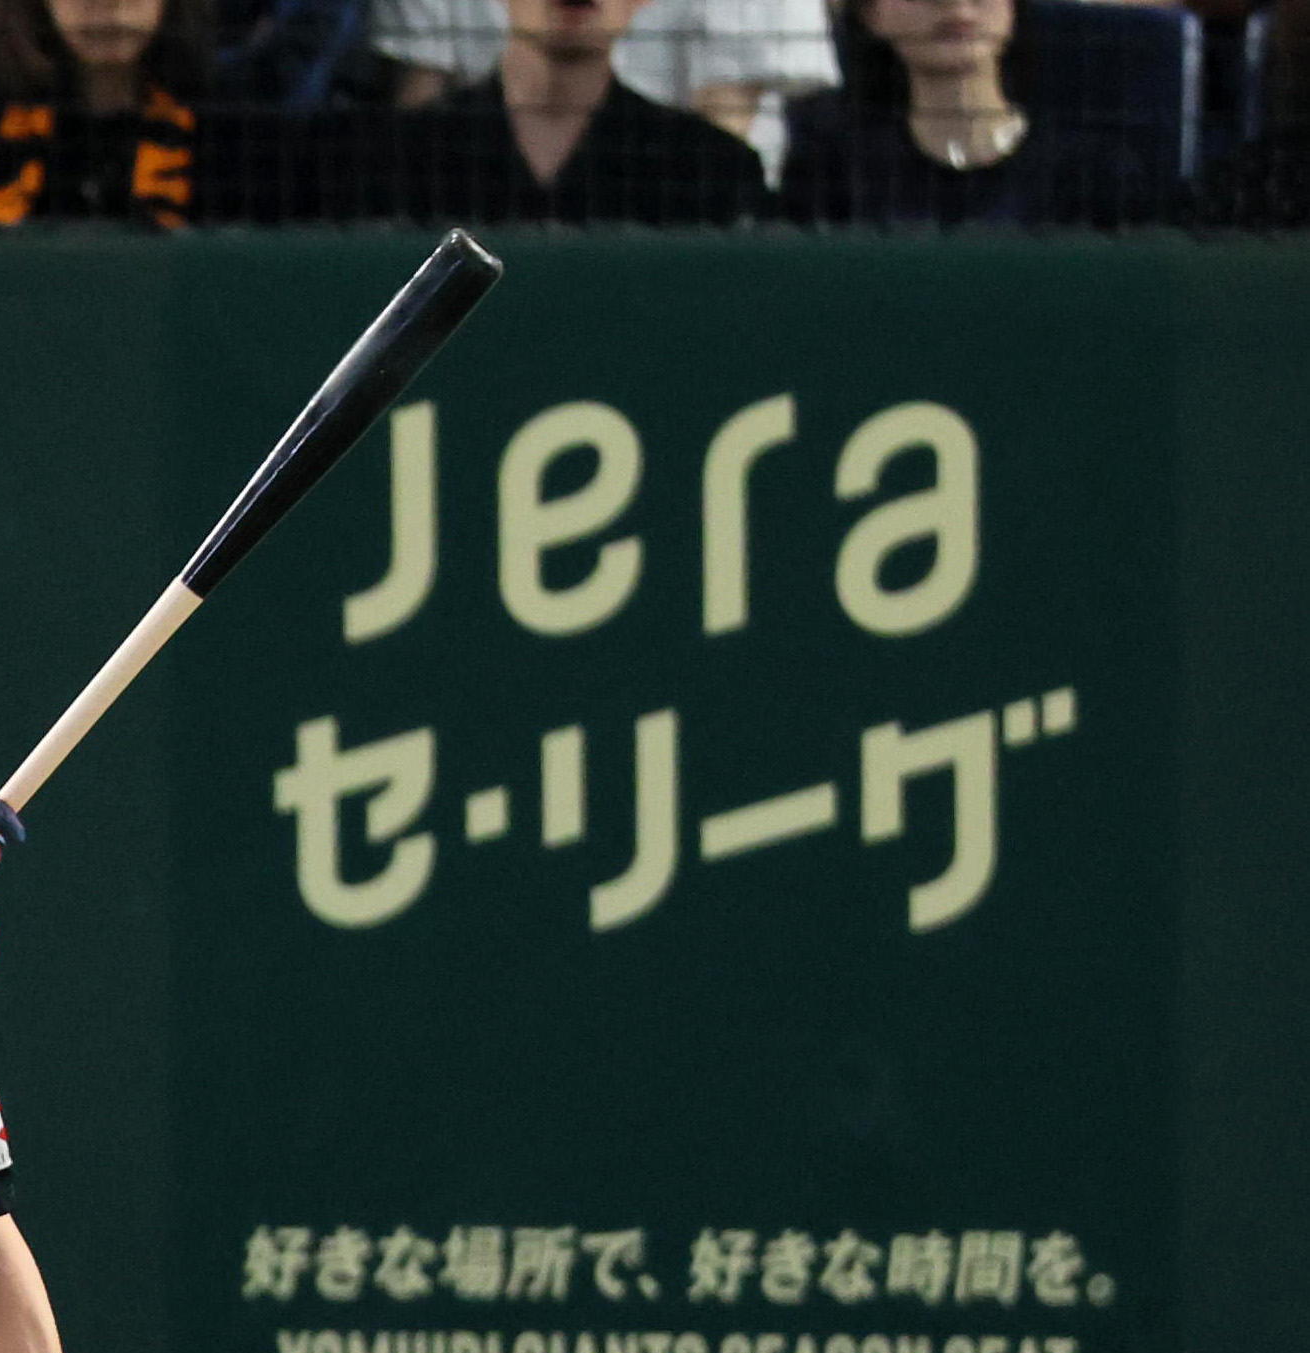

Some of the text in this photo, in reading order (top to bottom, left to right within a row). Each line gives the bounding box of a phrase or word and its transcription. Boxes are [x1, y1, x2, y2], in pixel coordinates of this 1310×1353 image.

[242, 1225, 1117, 1305] 好きな場所で、好きな時間を。
